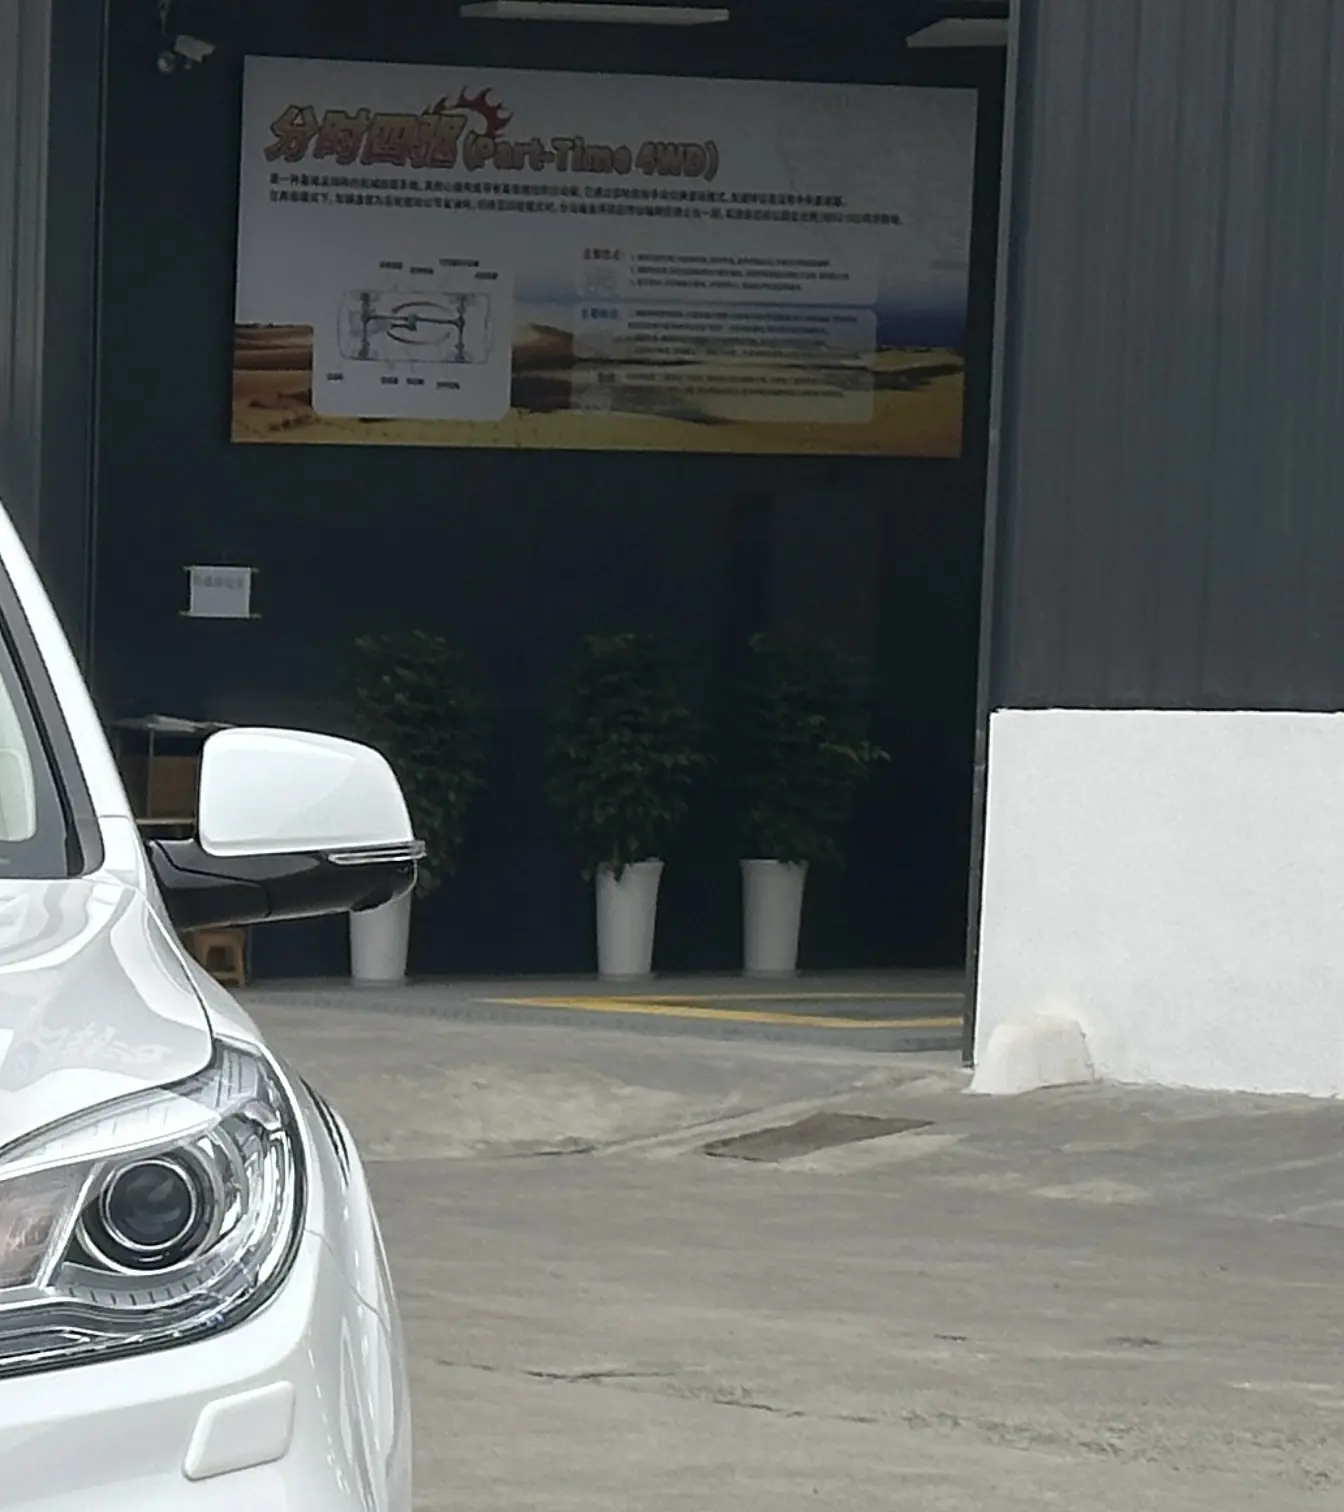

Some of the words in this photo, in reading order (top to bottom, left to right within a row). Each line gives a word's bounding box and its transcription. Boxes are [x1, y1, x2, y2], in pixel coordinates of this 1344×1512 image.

[263, 104, 468, 169] 分时四驱
[463, 129, 632, 175] (Part-Time
[635, 139, 720, 181] 4WD)
